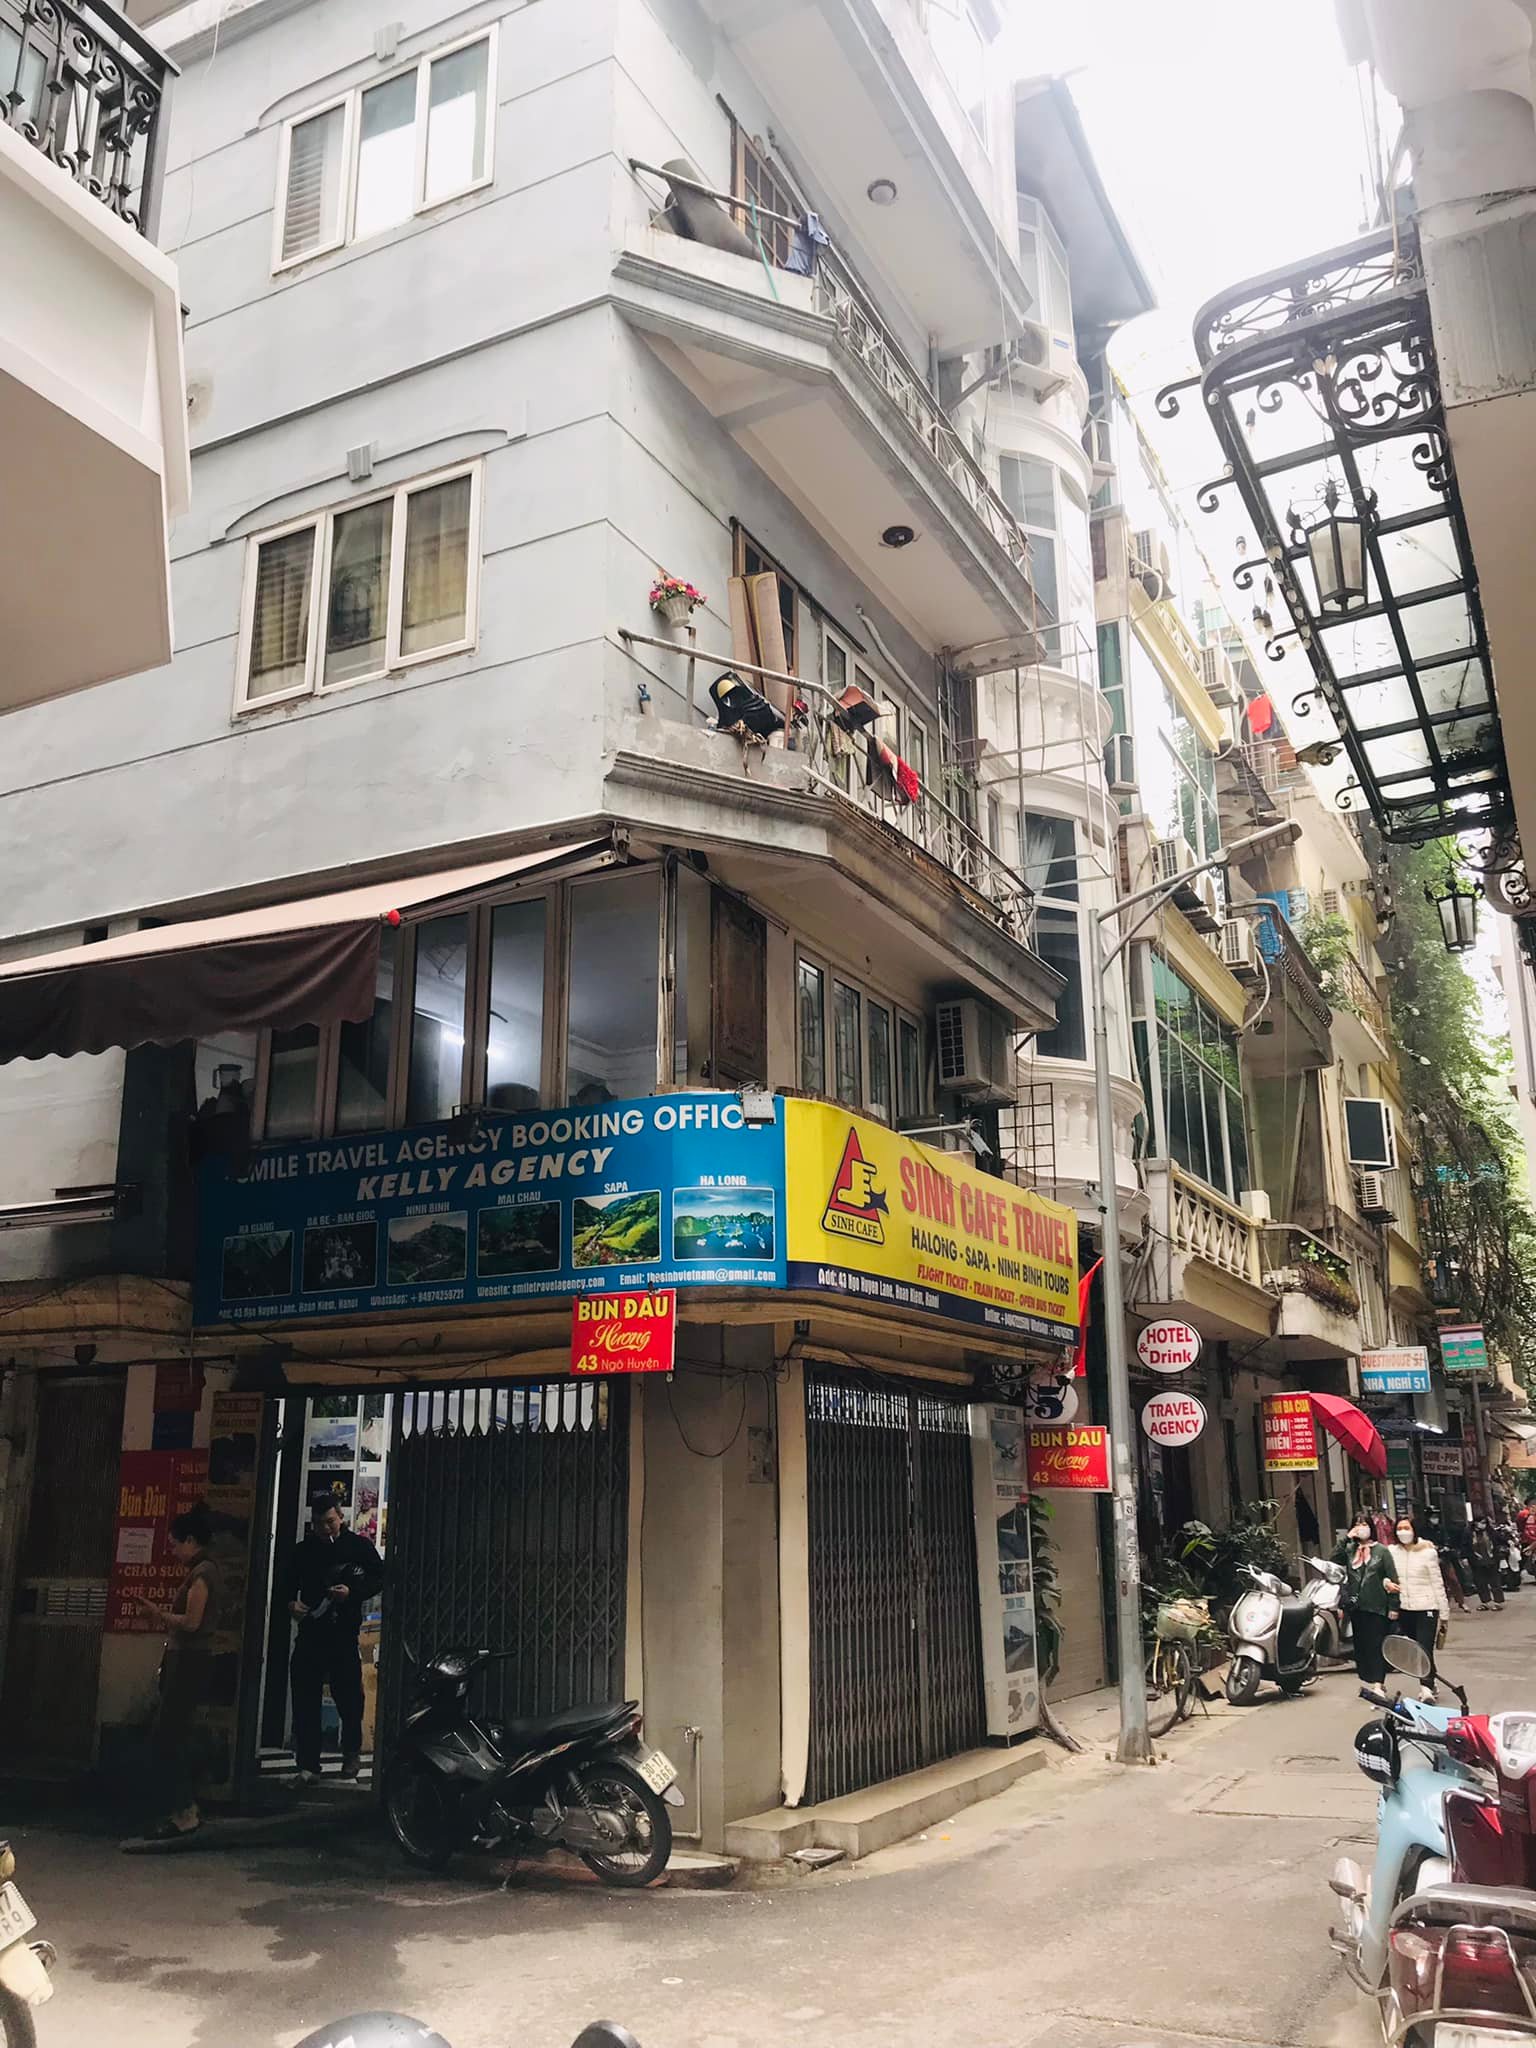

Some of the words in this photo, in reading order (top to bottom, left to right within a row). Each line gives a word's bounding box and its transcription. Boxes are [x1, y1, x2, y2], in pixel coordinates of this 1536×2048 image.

[236, 1153, 299, 1183] MILE
[305, 1143, 389, 1175] TRAVEL
[513, 1110, 644, 1148] BOOKING
[654, 1104, 762, 1130] OFFIC
[356, 1166, 458, 1201] KELLY
[464, 1147, 614, 1189] AGENCY
[700, 1176, 715, 1186] HA
[717, 1175, 747, 1186] LONG
[604, 1181, 628, 1193] SAPA
[498, 1193, 516, 1205] MAI
[518, 1191, 541, 1203] CHAU
[900, 1157, 957, 1228] SINH
[959, 1182, 1009, 1248] CAFE
[1012, 1203, 1074, 1268] TRAVEL
[831, 1214, 855, 1232] SINH
[856, 1222, 878, 1239] CAFE
[911, 1227, 958, 1261] HALONG
[965, 1246, 991, 1272] SAPA
[998, 1256, 1020, 1281] NINH
[1023, 1264, 1042, 1286] BINH
[1044, 1272, 1069, 1296] TOURS
[620, 1273, 645, 1285] Email:
[477, 1286, 511, 1297] Website:
[917, 1264, 944, 1285] FLIGHT
[946, 1272, 969, 1290] TICKET
[974, 1281, 993, 1299] TRAIN
[994, 1287, 1014, 1304] TICKET
[1019, 1294, 1035, 1309] OPEN
[1036, 1300, 1047, 1312] BUS
[1048, 1303, 1066, 1317] TICKET
[1147, 1327, 1193, 1344] HOTEL
[1139, 1343, 1148, 1354] &
[1150, 1350, 1192, 1364] Drink
[577, 1354, 598, 1371] 43
[1363, 1375, 1385, 1391] NHÀ
[1413, 1377, 1426, 1390] 51
[1149, 1402, 1196, 1418] TRAVEL
[1150, 1420, 1200, 1436] AGENCY
[1265, 1416, 1288, 1432] BÚN
[1033, 1472, 1048, 1483] 43
